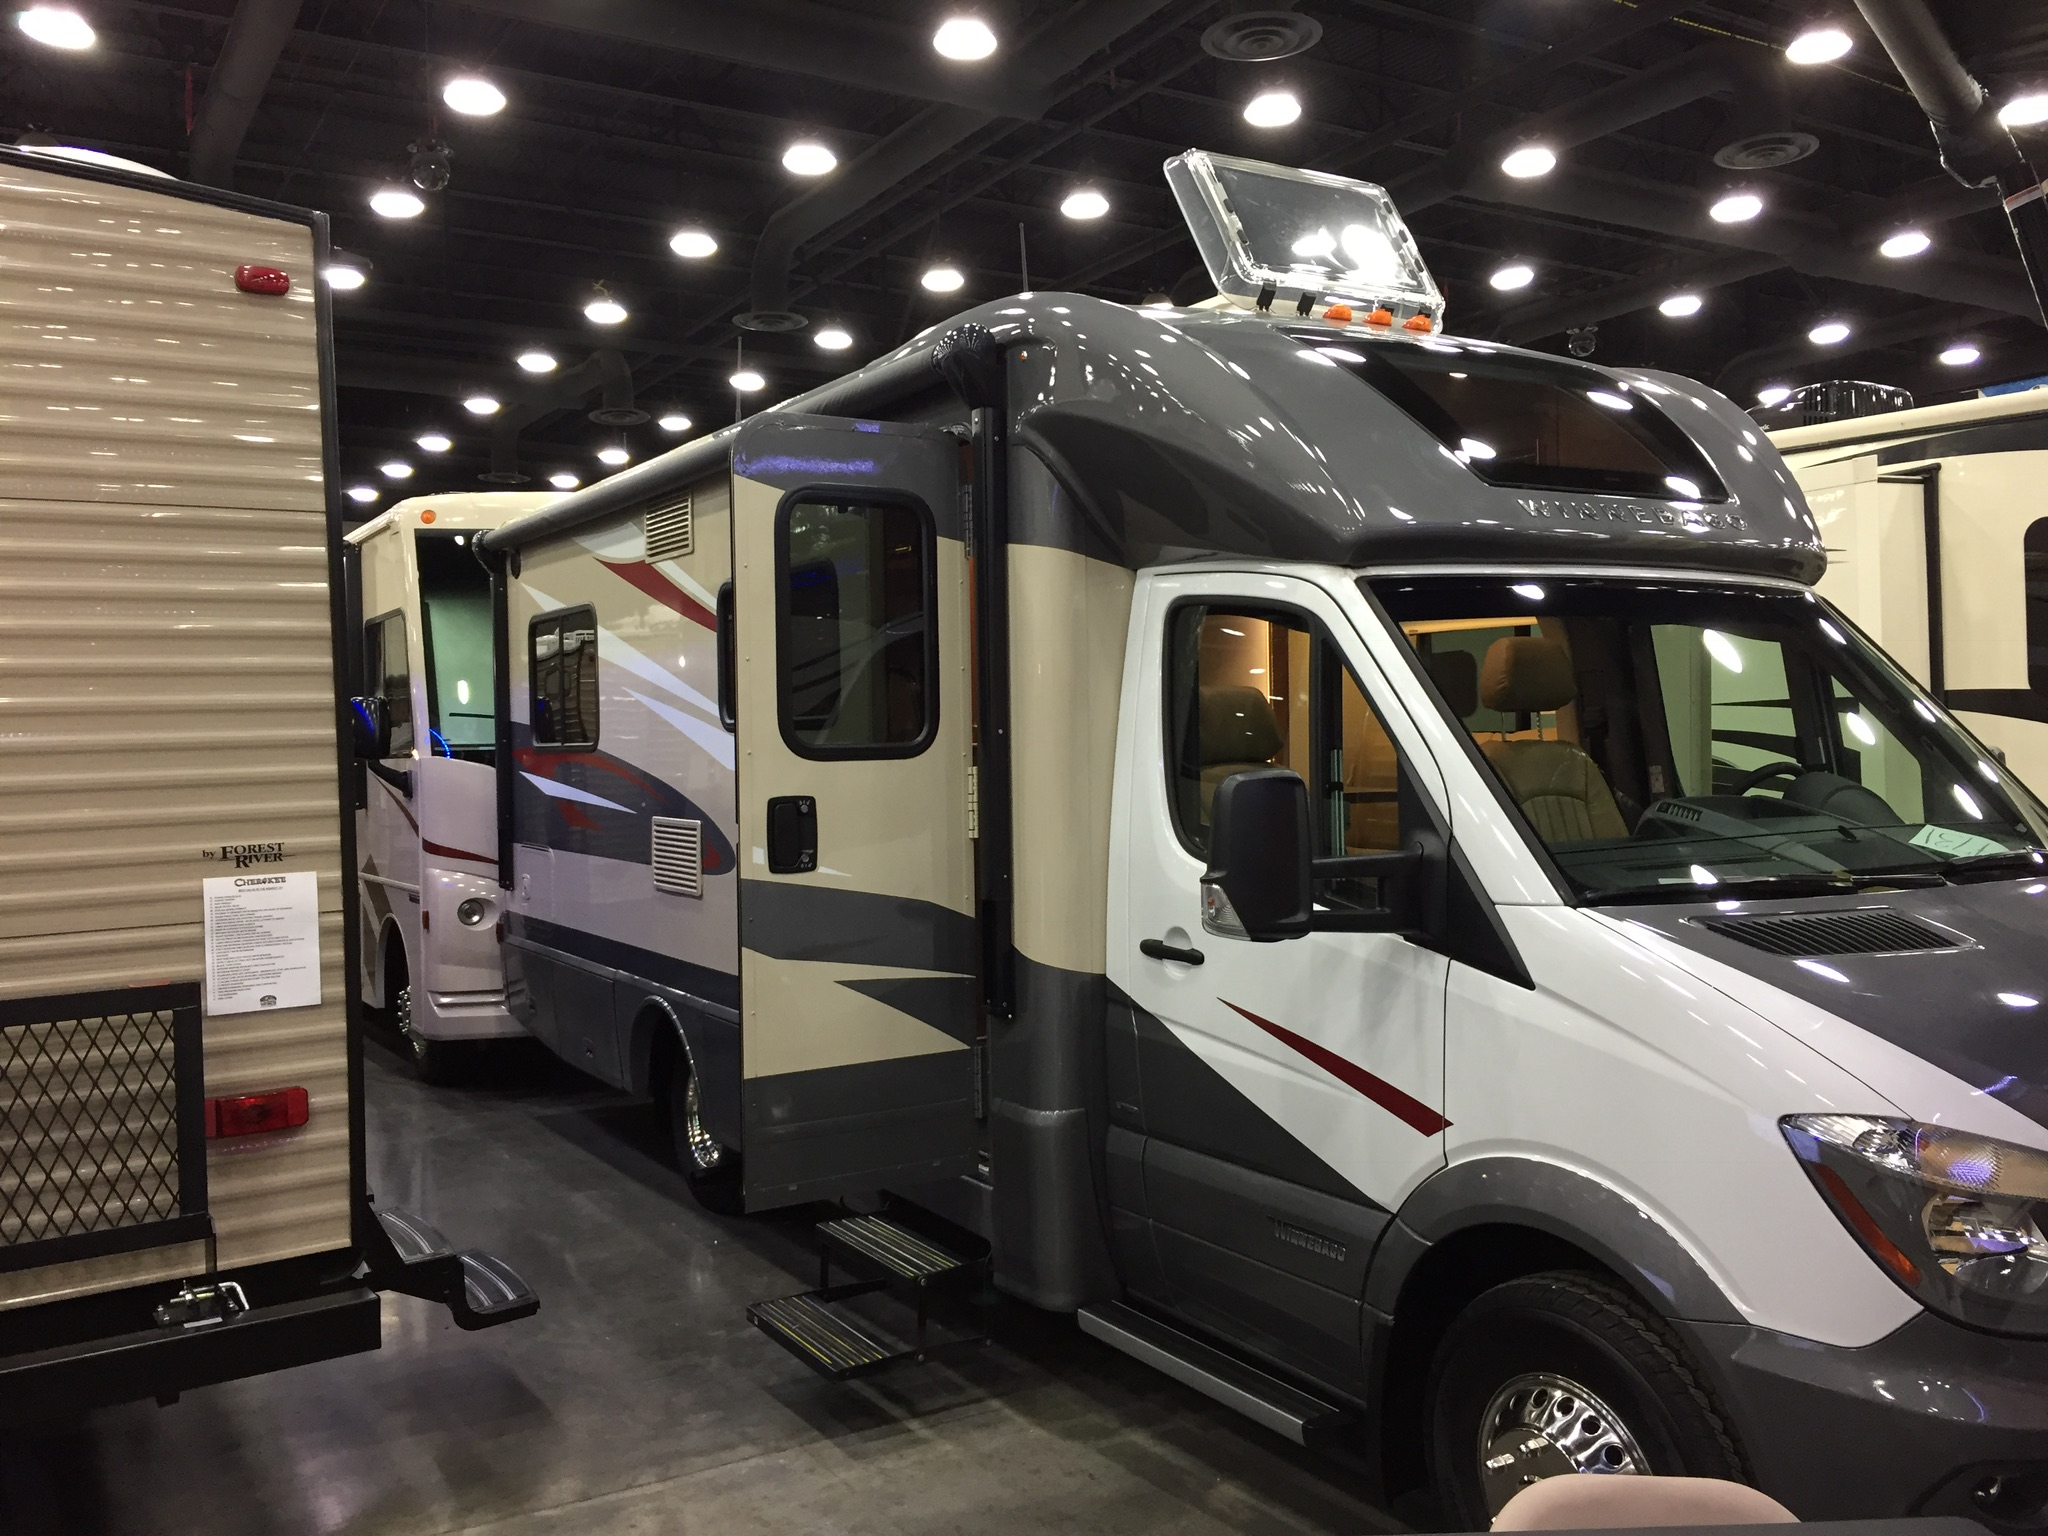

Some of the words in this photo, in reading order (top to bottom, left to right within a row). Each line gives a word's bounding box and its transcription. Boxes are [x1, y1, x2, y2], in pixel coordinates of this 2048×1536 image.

[1517, 498, 1748, 531] WINNEBAGO
[202, 850, 216, 860] by
[219, 842, 285, 861] FOREST
[233, 852, 284, 869] RIVER
